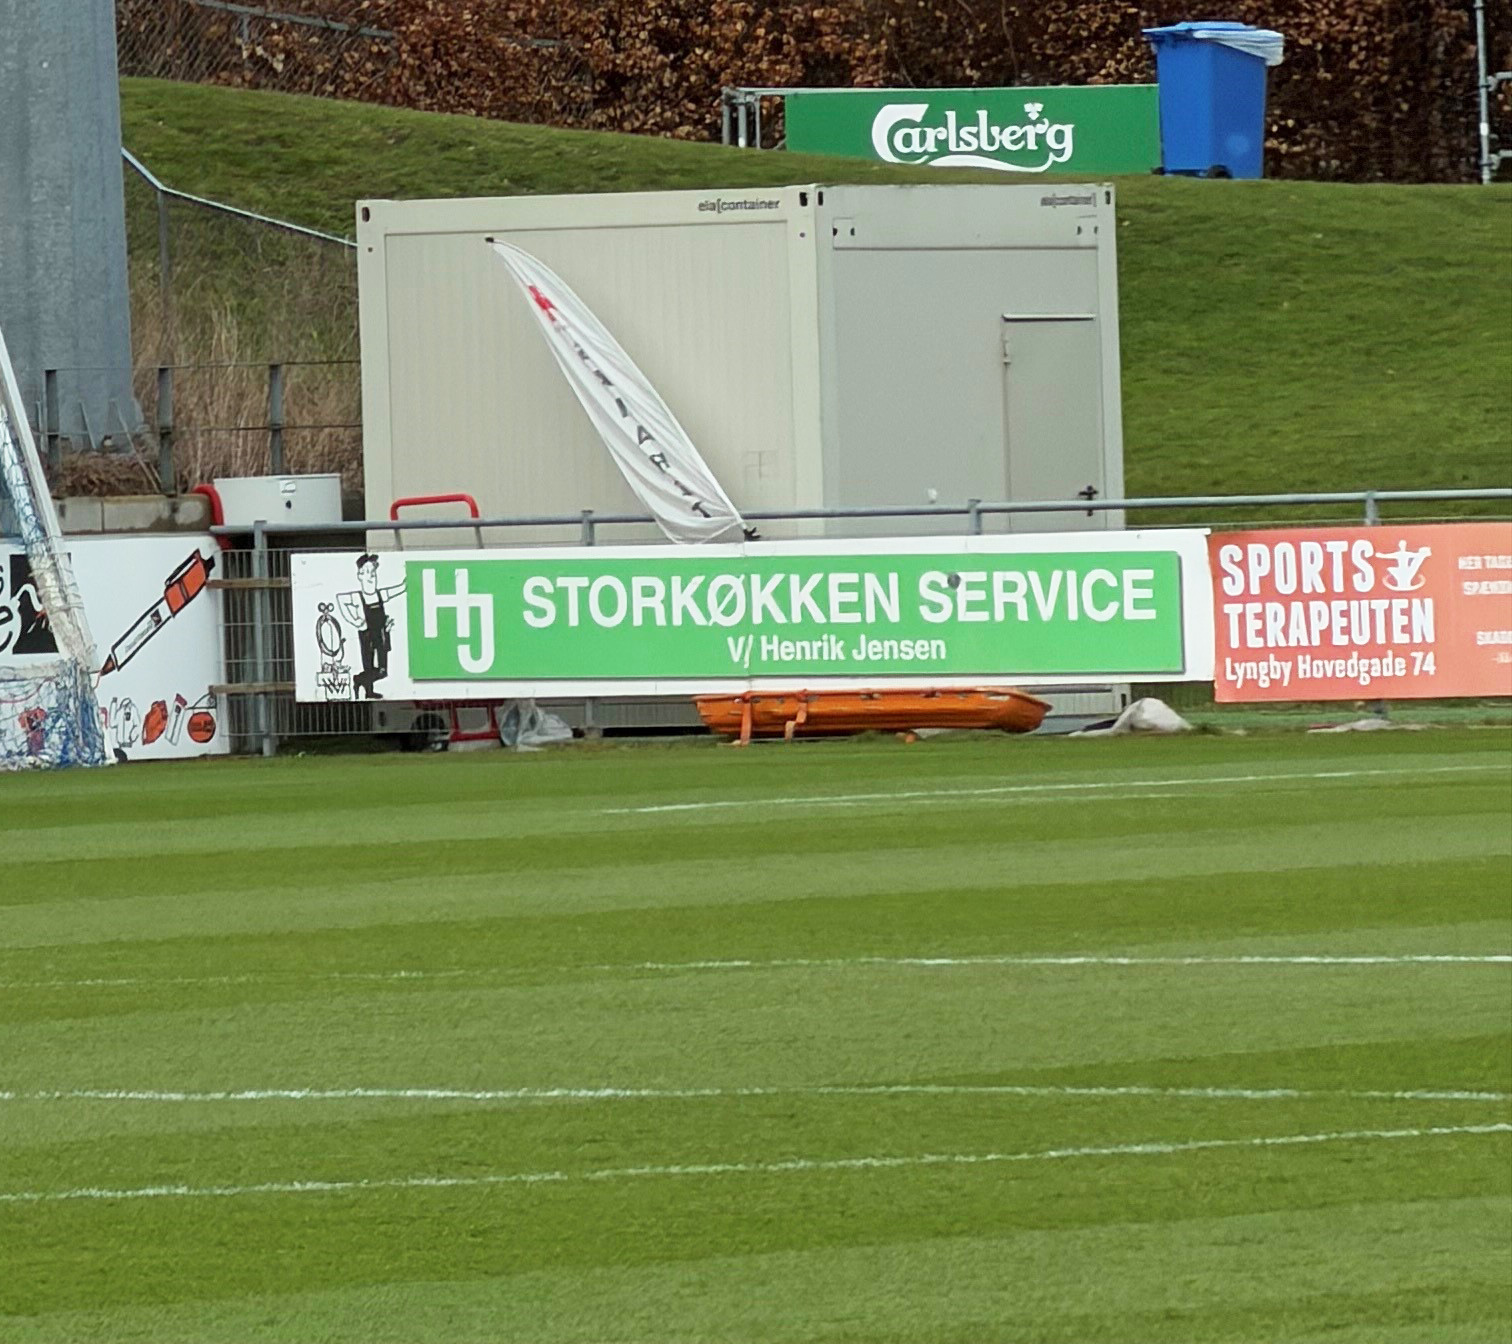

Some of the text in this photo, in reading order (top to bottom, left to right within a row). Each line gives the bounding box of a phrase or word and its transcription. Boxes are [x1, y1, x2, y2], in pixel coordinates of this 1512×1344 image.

[872, 102, 1075, 173] Carlsberg
[1219, 539, 1375, 596] SPORTS
[422, 568, 1157, 674] HJ STORKØKKEN SERVICE
[760, 635, 845, 661] Henrik
[852, 632, 946, 662] Jensen
[1223, 598, 1435, 649] TERAPEUTEN
[1225, 650, 1437, 689] Lyngby Hovedgade 74
